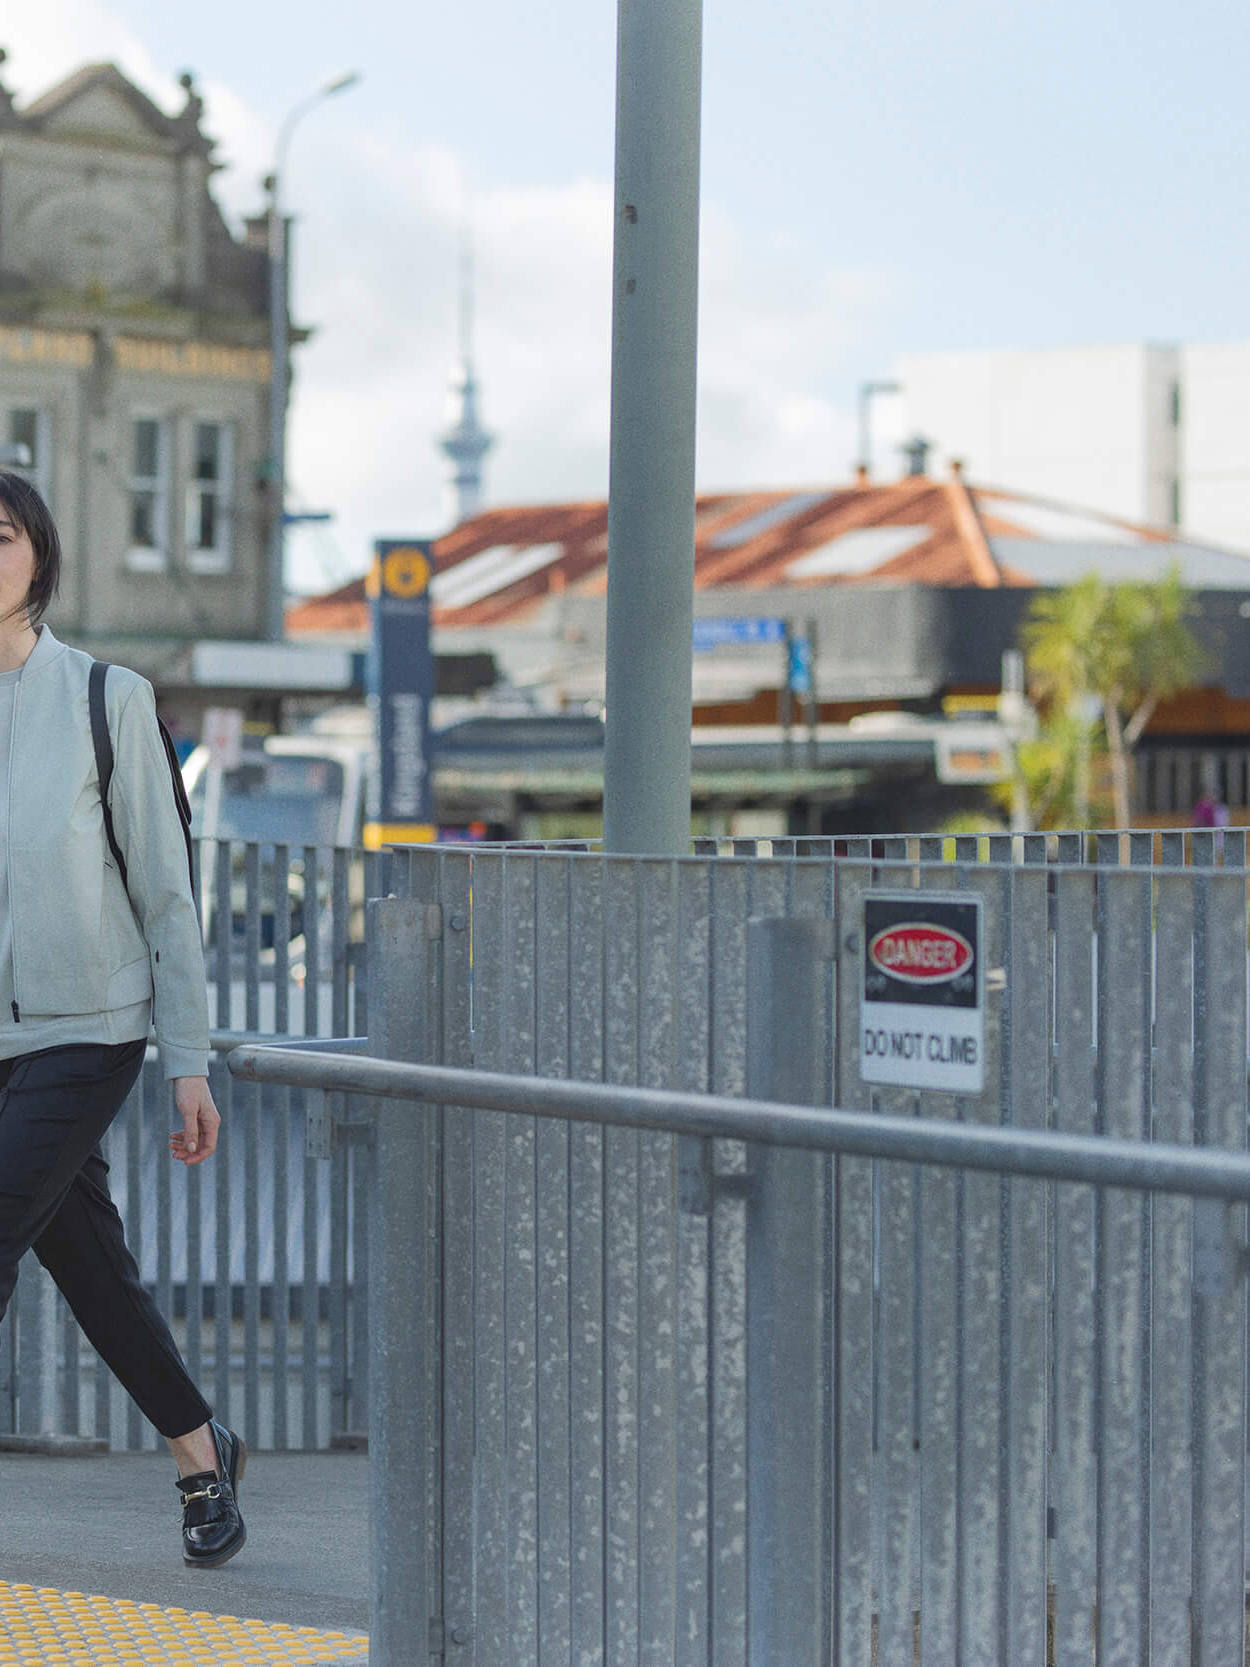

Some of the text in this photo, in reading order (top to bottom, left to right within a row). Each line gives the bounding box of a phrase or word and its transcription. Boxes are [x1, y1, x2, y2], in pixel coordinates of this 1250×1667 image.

[881, 938, 958, 969] DANGER
[864, 1028, 977, 1065] DO NOT CLIMB
